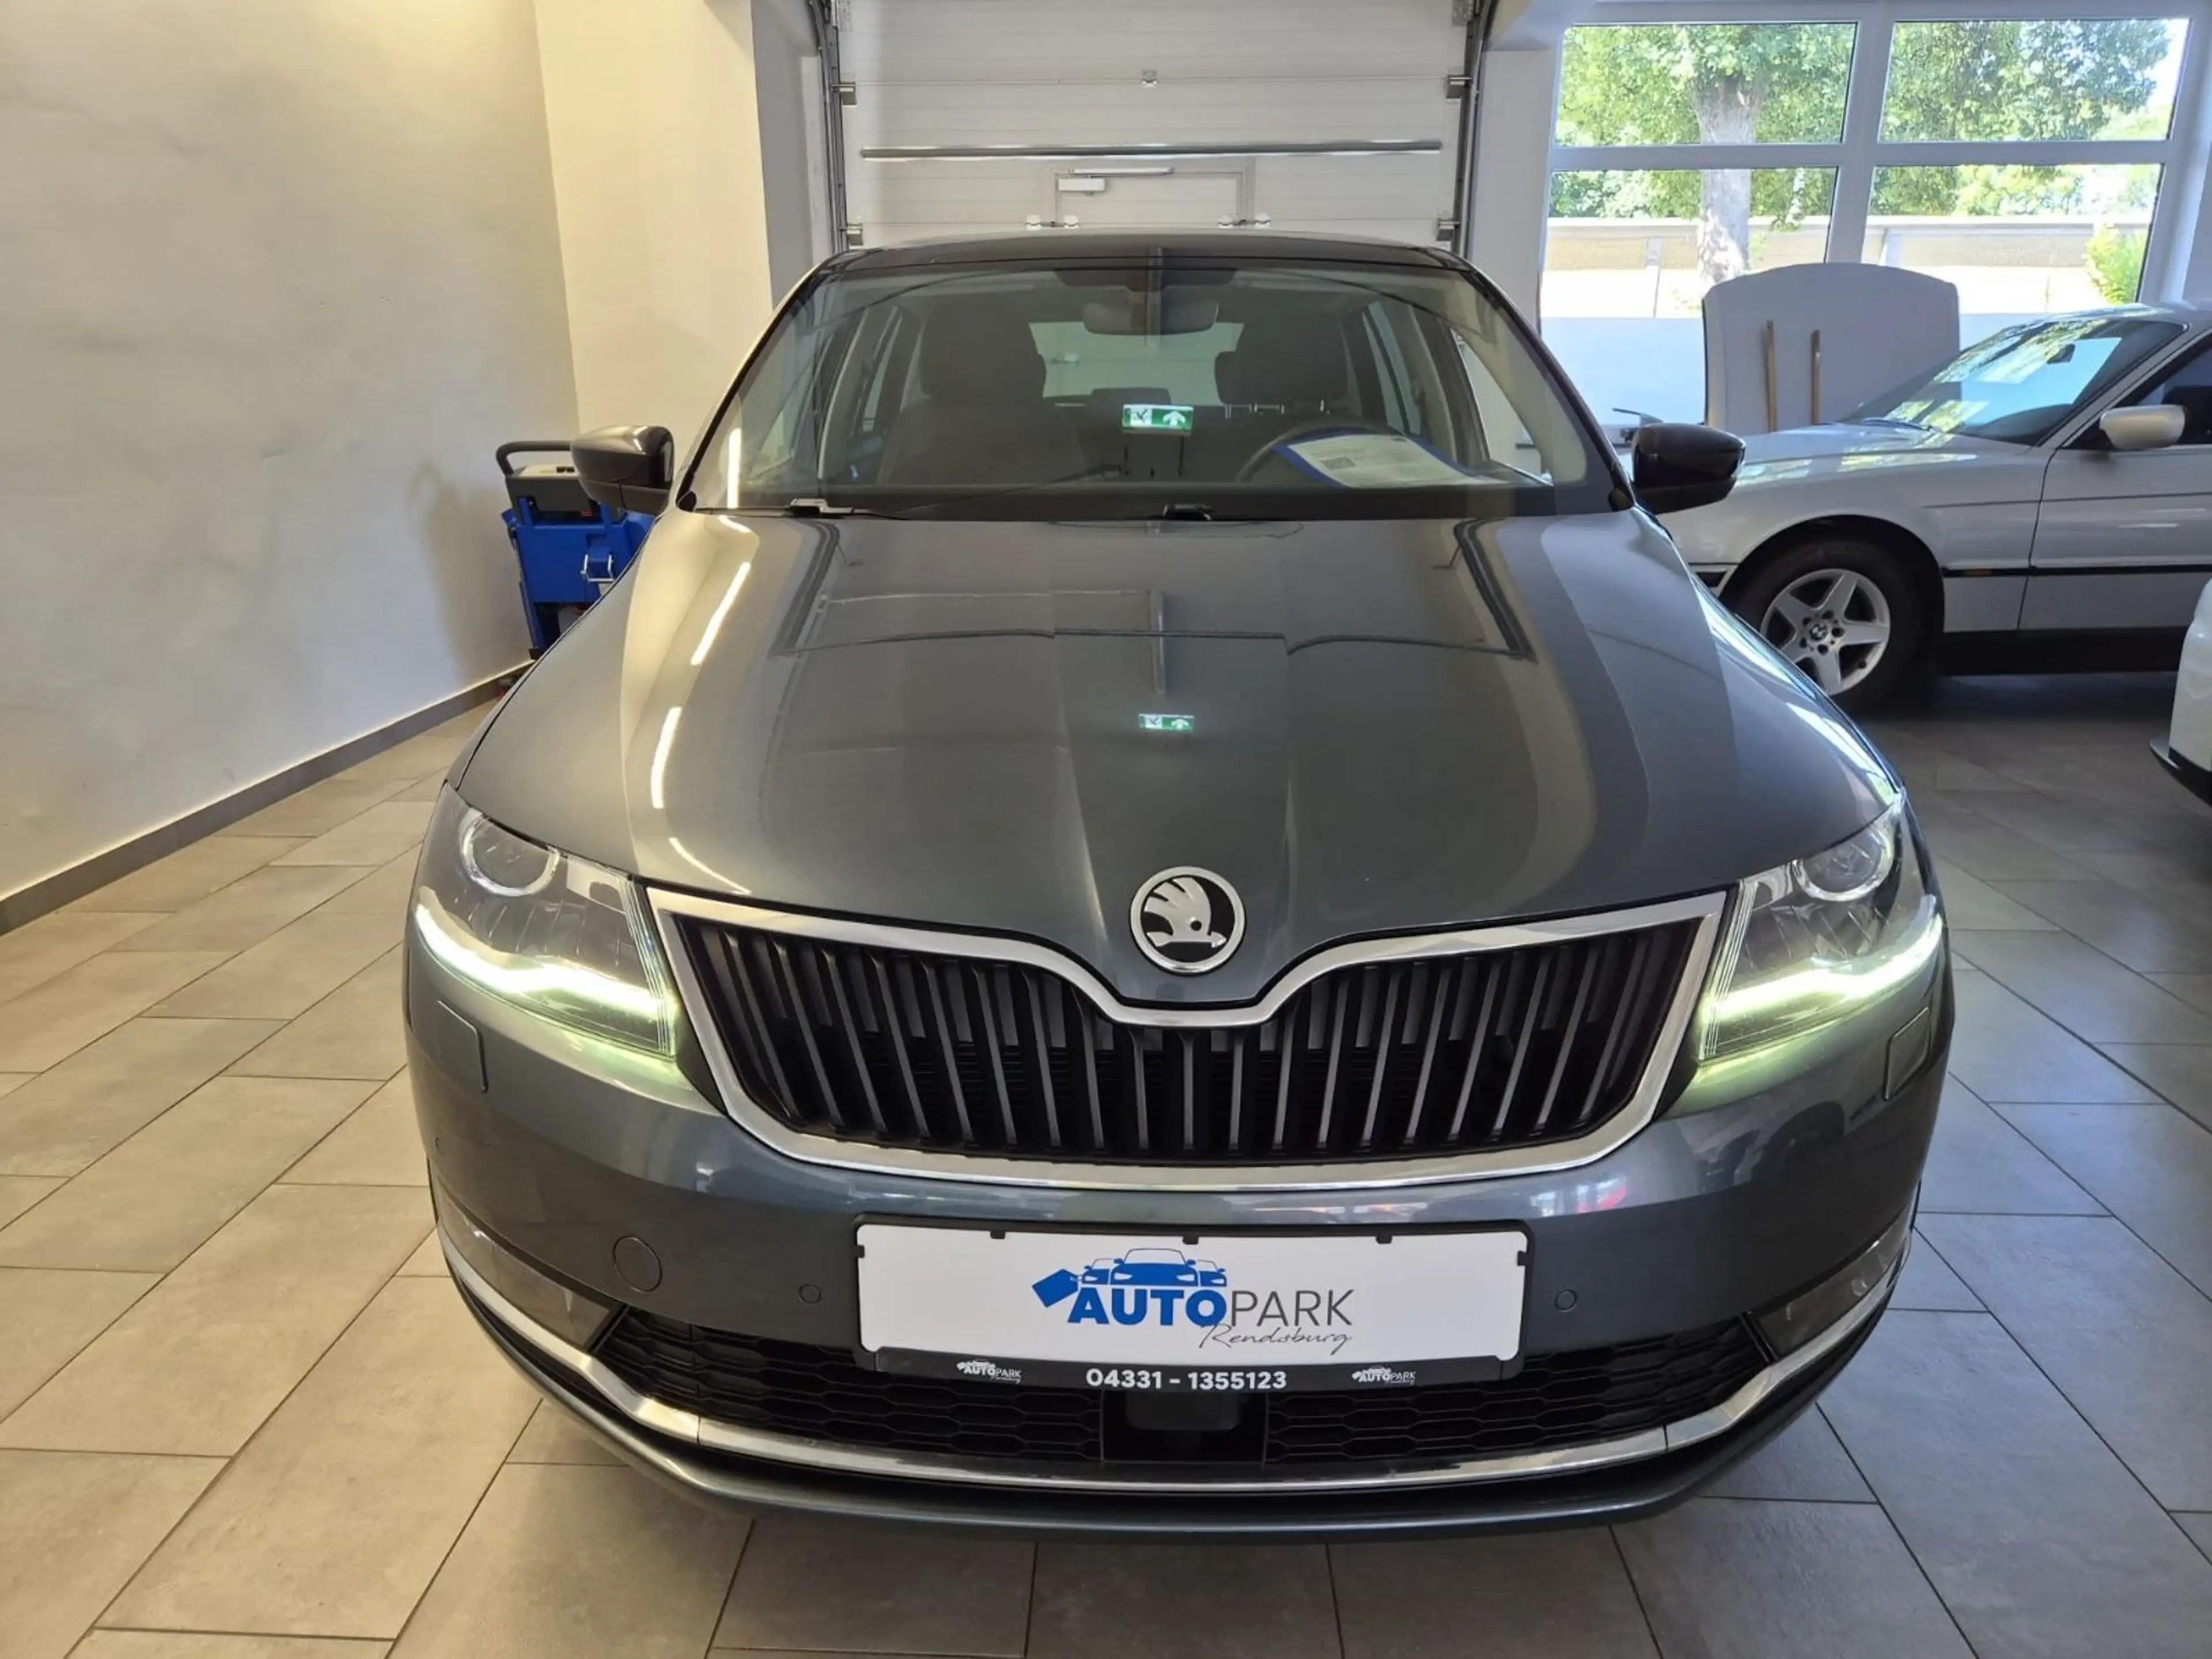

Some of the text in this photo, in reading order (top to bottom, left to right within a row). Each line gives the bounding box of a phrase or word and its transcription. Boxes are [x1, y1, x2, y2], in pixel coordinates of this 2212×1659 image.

[1067, 1287, 1355, 1327] AUTOPARK
[1199, 1323, 1353, 1355] Rendsburg
[963, 1365, 1021, 1378] AUTOPARK
[1086, 1368, 1162, 1389] 04331
[1187, 1371, 1287, 1390] 1355123
[1358, 1370, 1416, 1382] AUTOPARK
